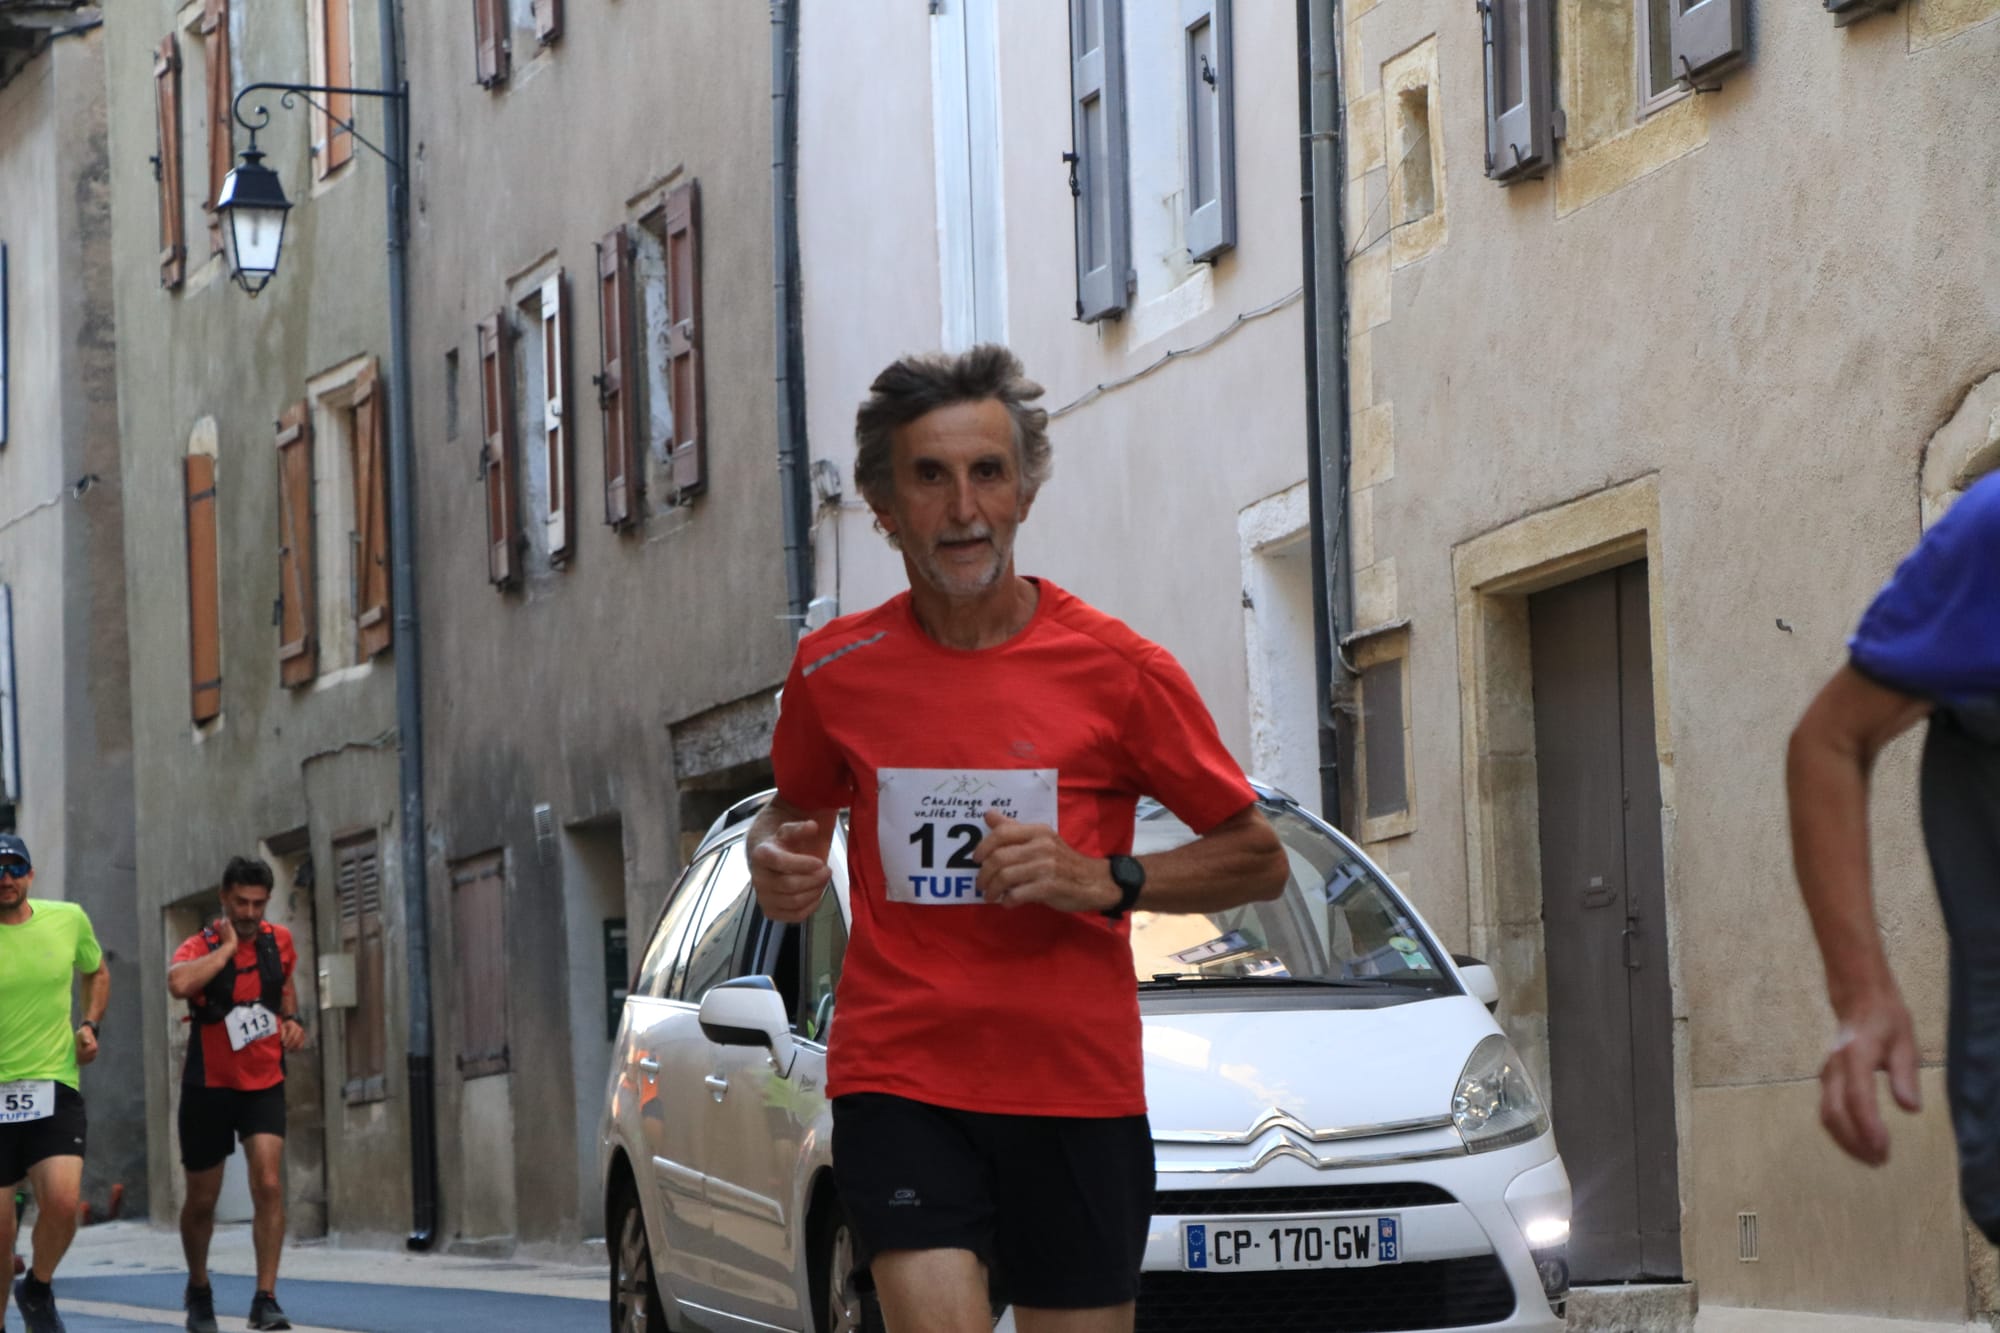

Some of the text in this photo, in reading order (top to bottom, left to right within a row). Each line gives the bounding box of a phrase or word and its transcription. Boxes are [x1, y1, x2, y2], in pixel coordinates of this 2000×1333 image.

[921, 796, 1012, 809] Challenge des
[909, 823, 984, 868] 12
[240, 1014, 269, 1035] 113
[5, 1094, 34, 1110] 55
[1193, 1225, 1396, 1265] F CP-170-GW 13
